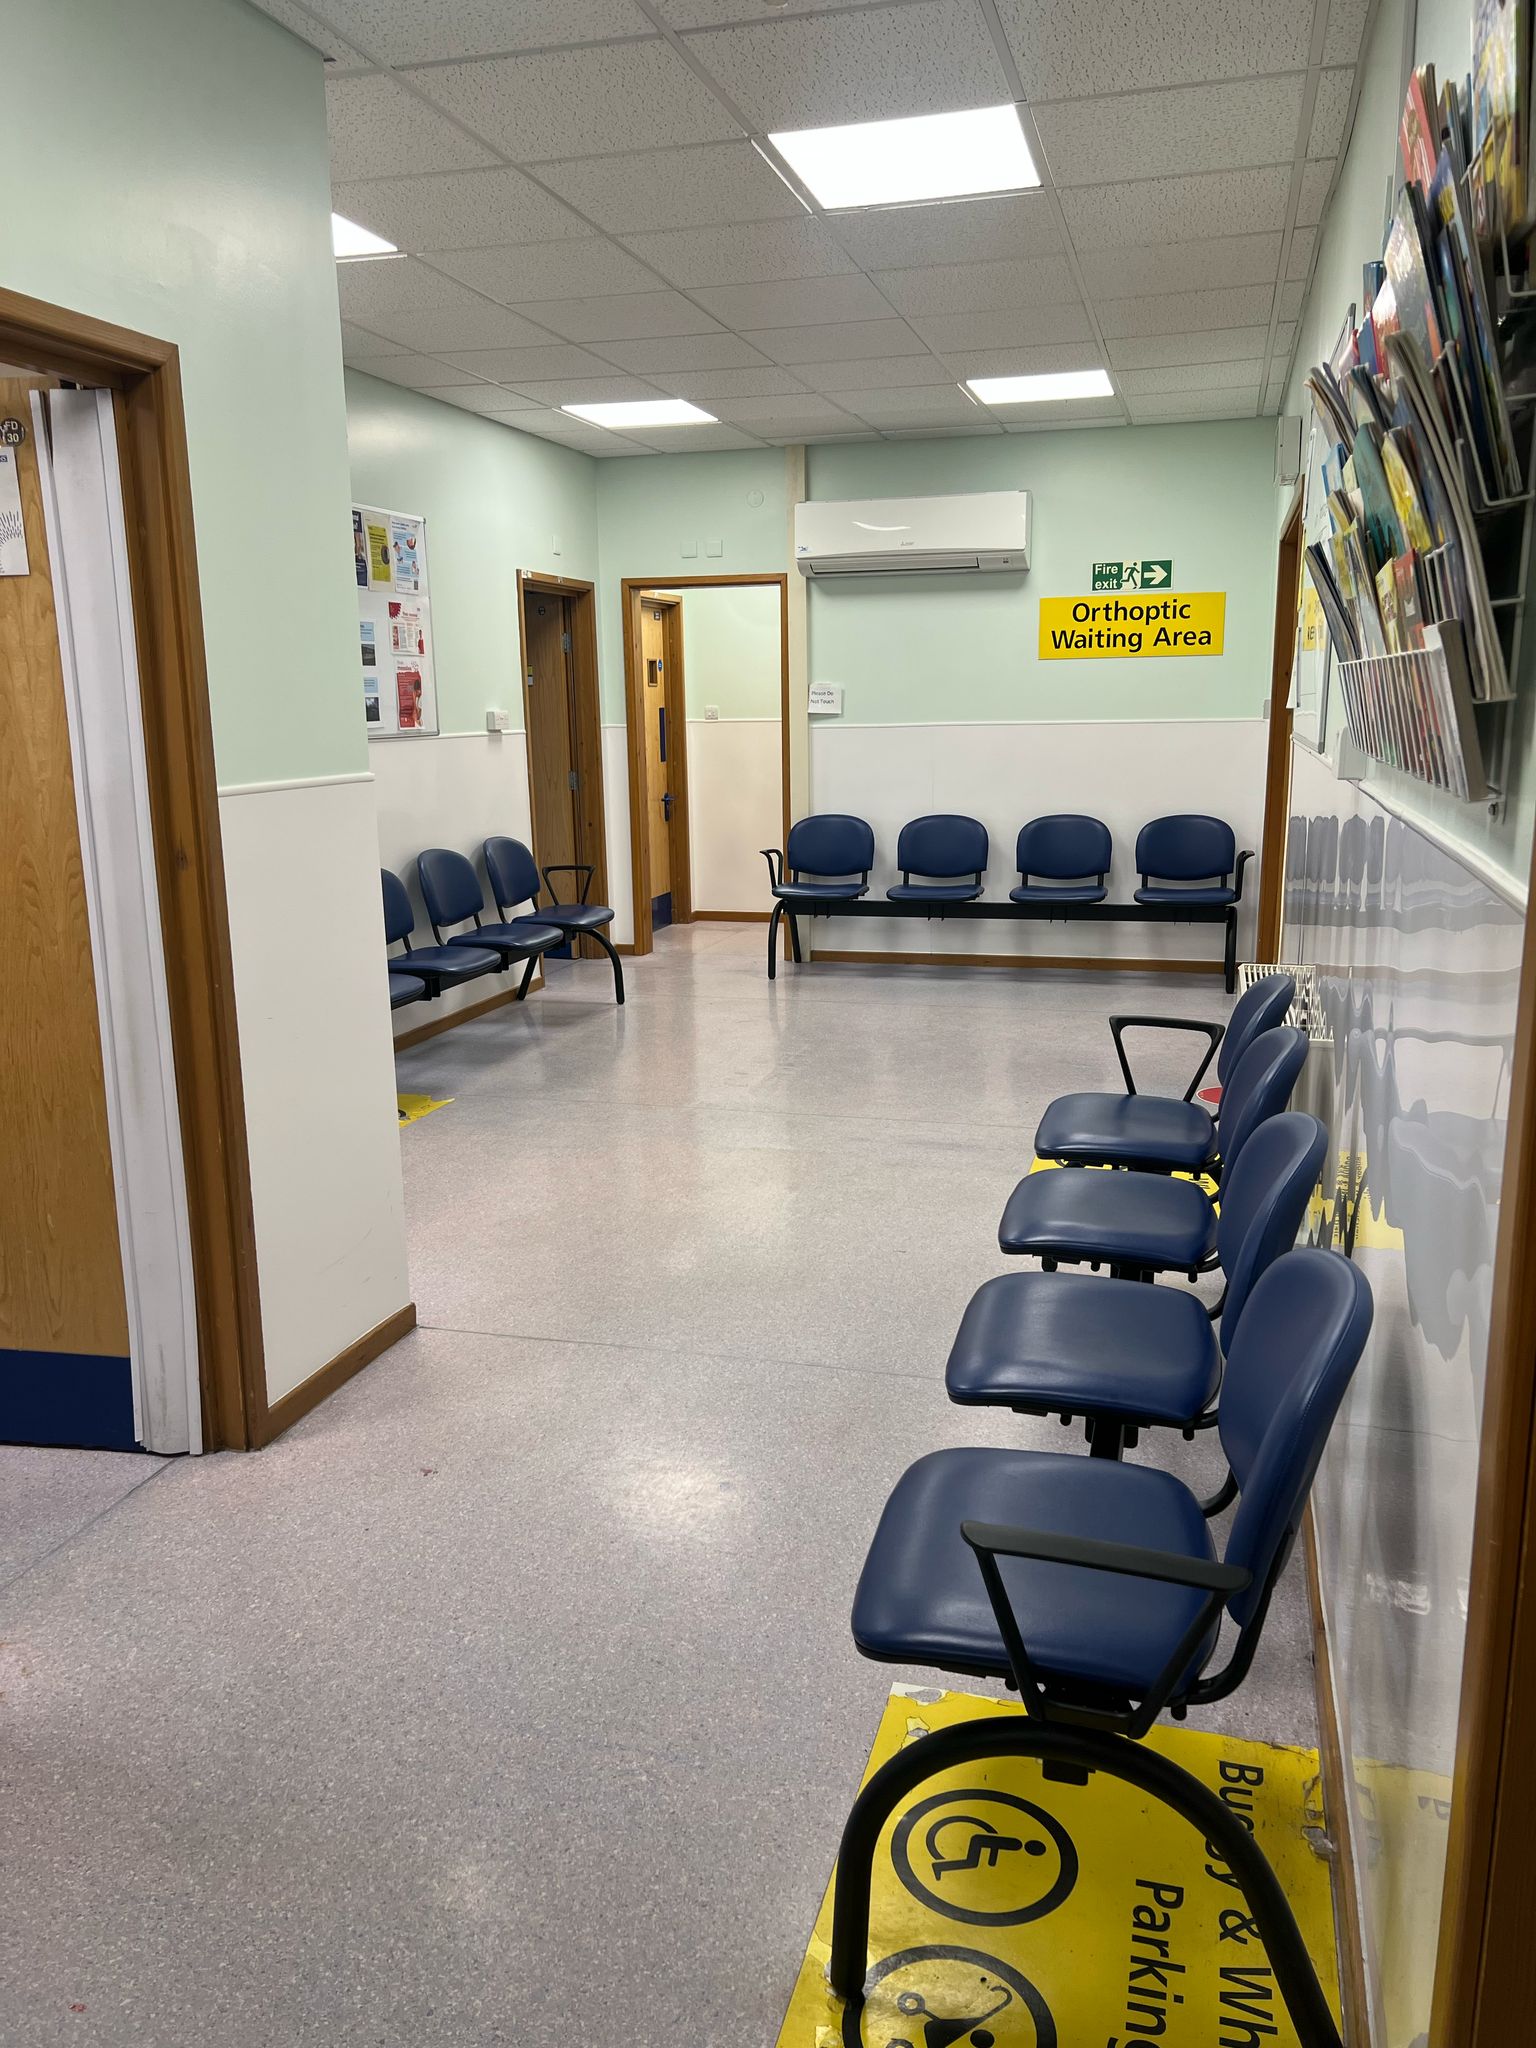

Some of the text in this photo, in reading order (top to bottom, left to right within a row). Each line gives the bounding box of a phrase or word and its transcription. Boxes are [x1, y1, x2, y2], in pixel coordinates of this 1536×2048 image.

[7, 433, 19, 443] 30
[1095, 563, 1119, 576] Fire
[1094, 578, 1118, 590] exit
[1072, 599, 1191, 626] Orthoptic
[1051, 627, 1212, 653] Waiting Area
[1205, 1760, 1264, 1889] Buy
